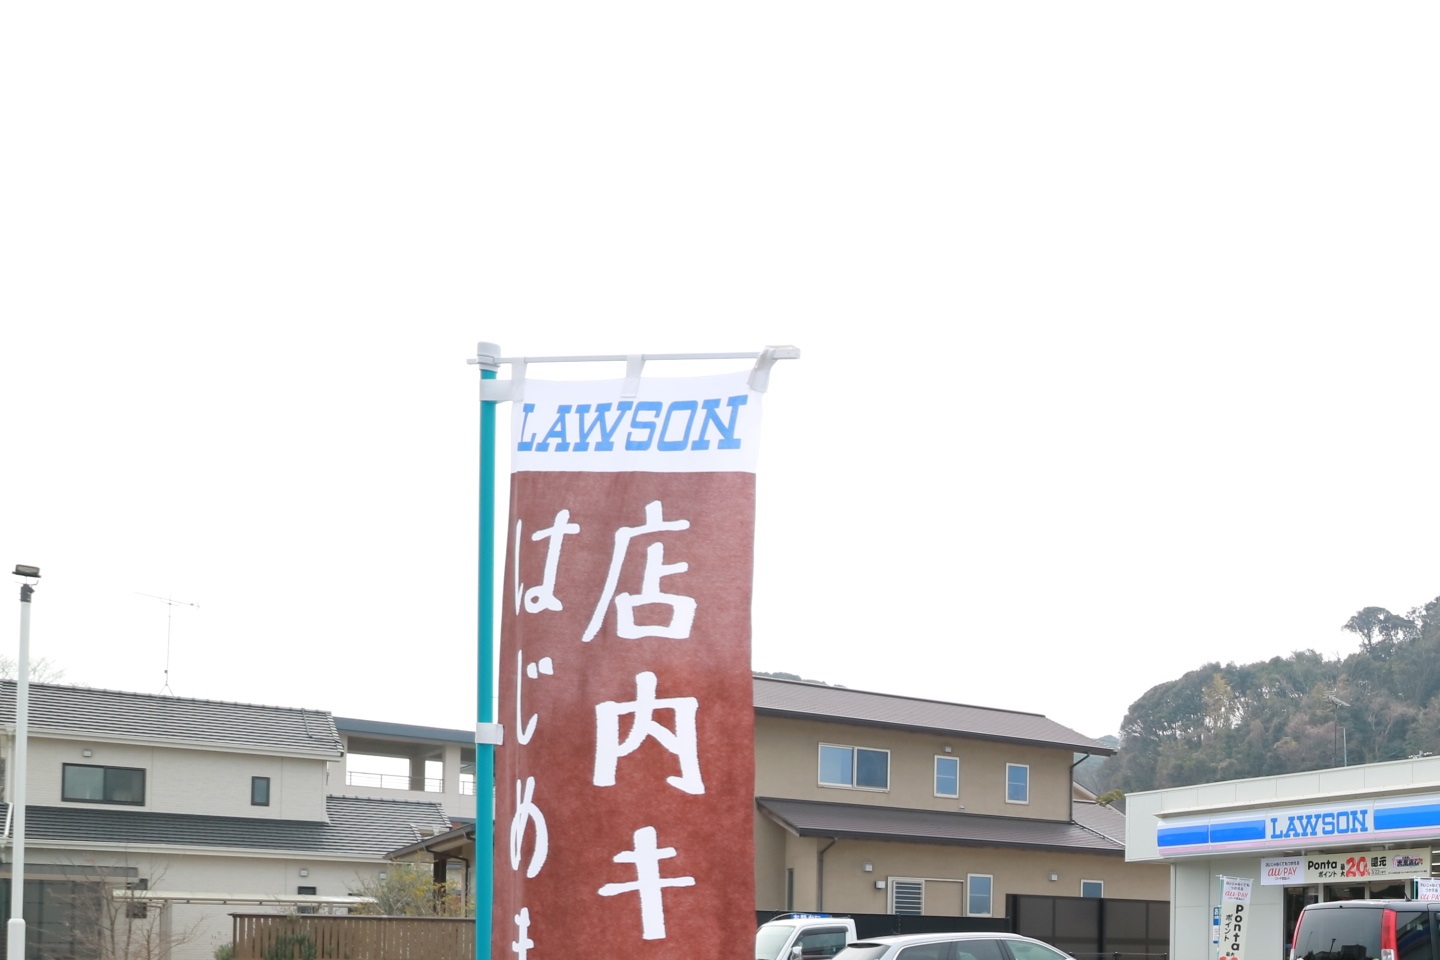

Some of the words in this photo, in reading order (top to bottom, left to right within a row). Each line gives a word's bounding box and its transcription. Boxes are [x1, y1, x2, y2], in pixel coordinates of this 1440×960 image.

[516, 394, 749, 453] LAWSON
[1270, 808, 1369, 840] LAWSON
[1283, 866, 1298, 876] PAY
[1307, 858, 1338, 871] Ponta
[1231, 904, 1245, 951] Ponta
